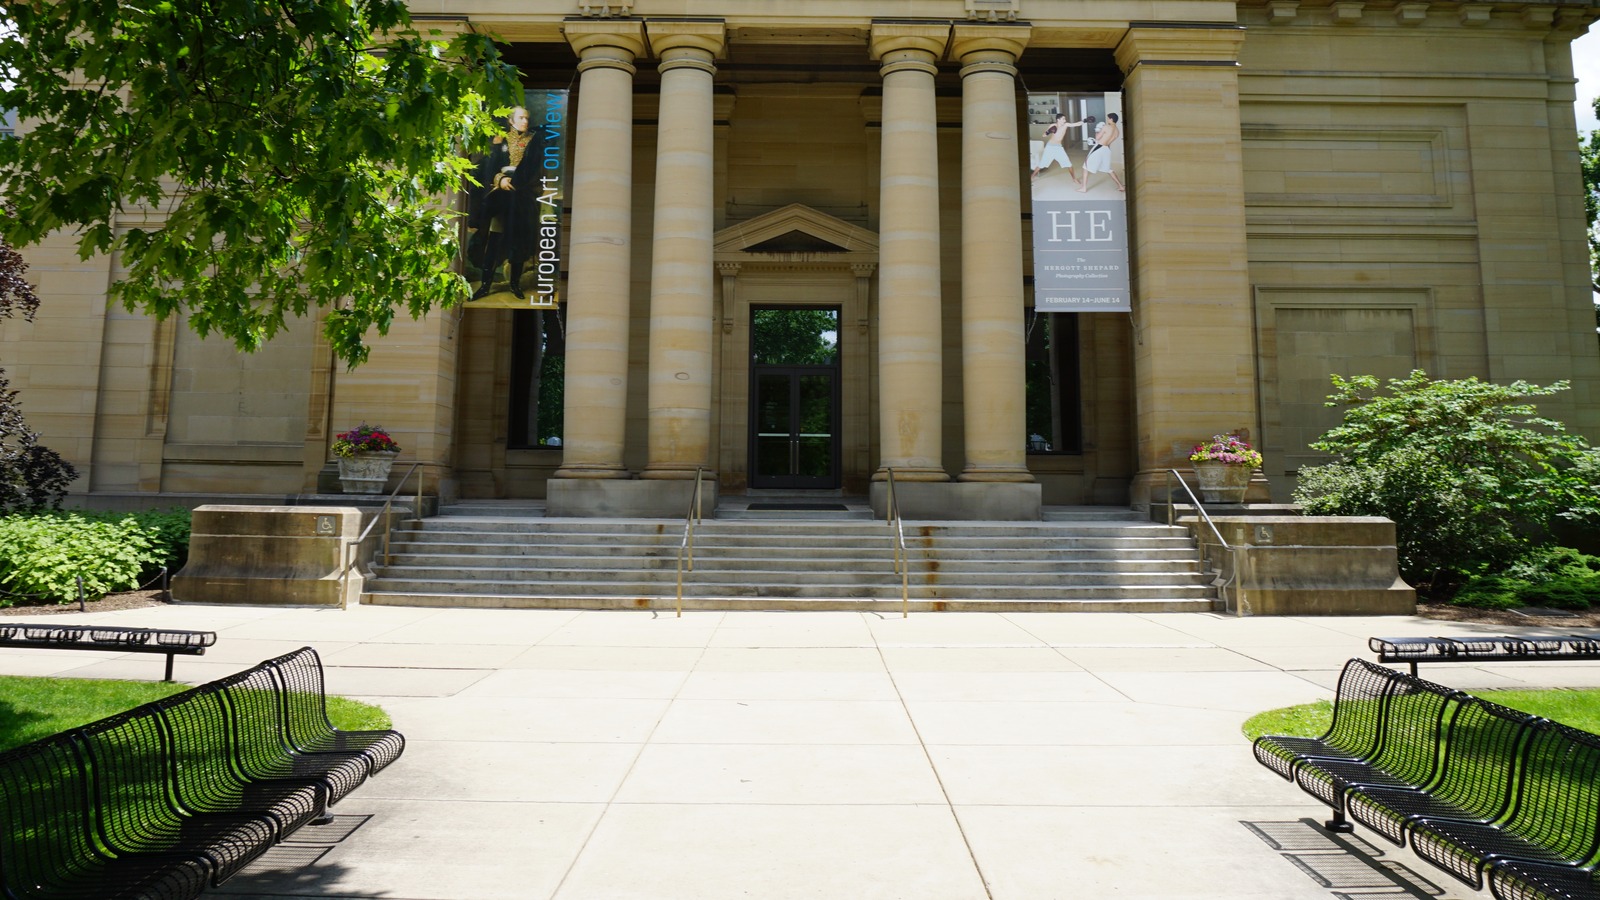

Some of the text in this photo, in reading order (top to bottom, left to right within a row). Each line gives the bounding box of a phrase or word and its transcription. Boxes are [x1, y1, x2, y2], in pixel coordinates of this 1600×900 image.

[530, 93, 563, 306] European Art on view
[1046, 210, 1113, 242] HE
